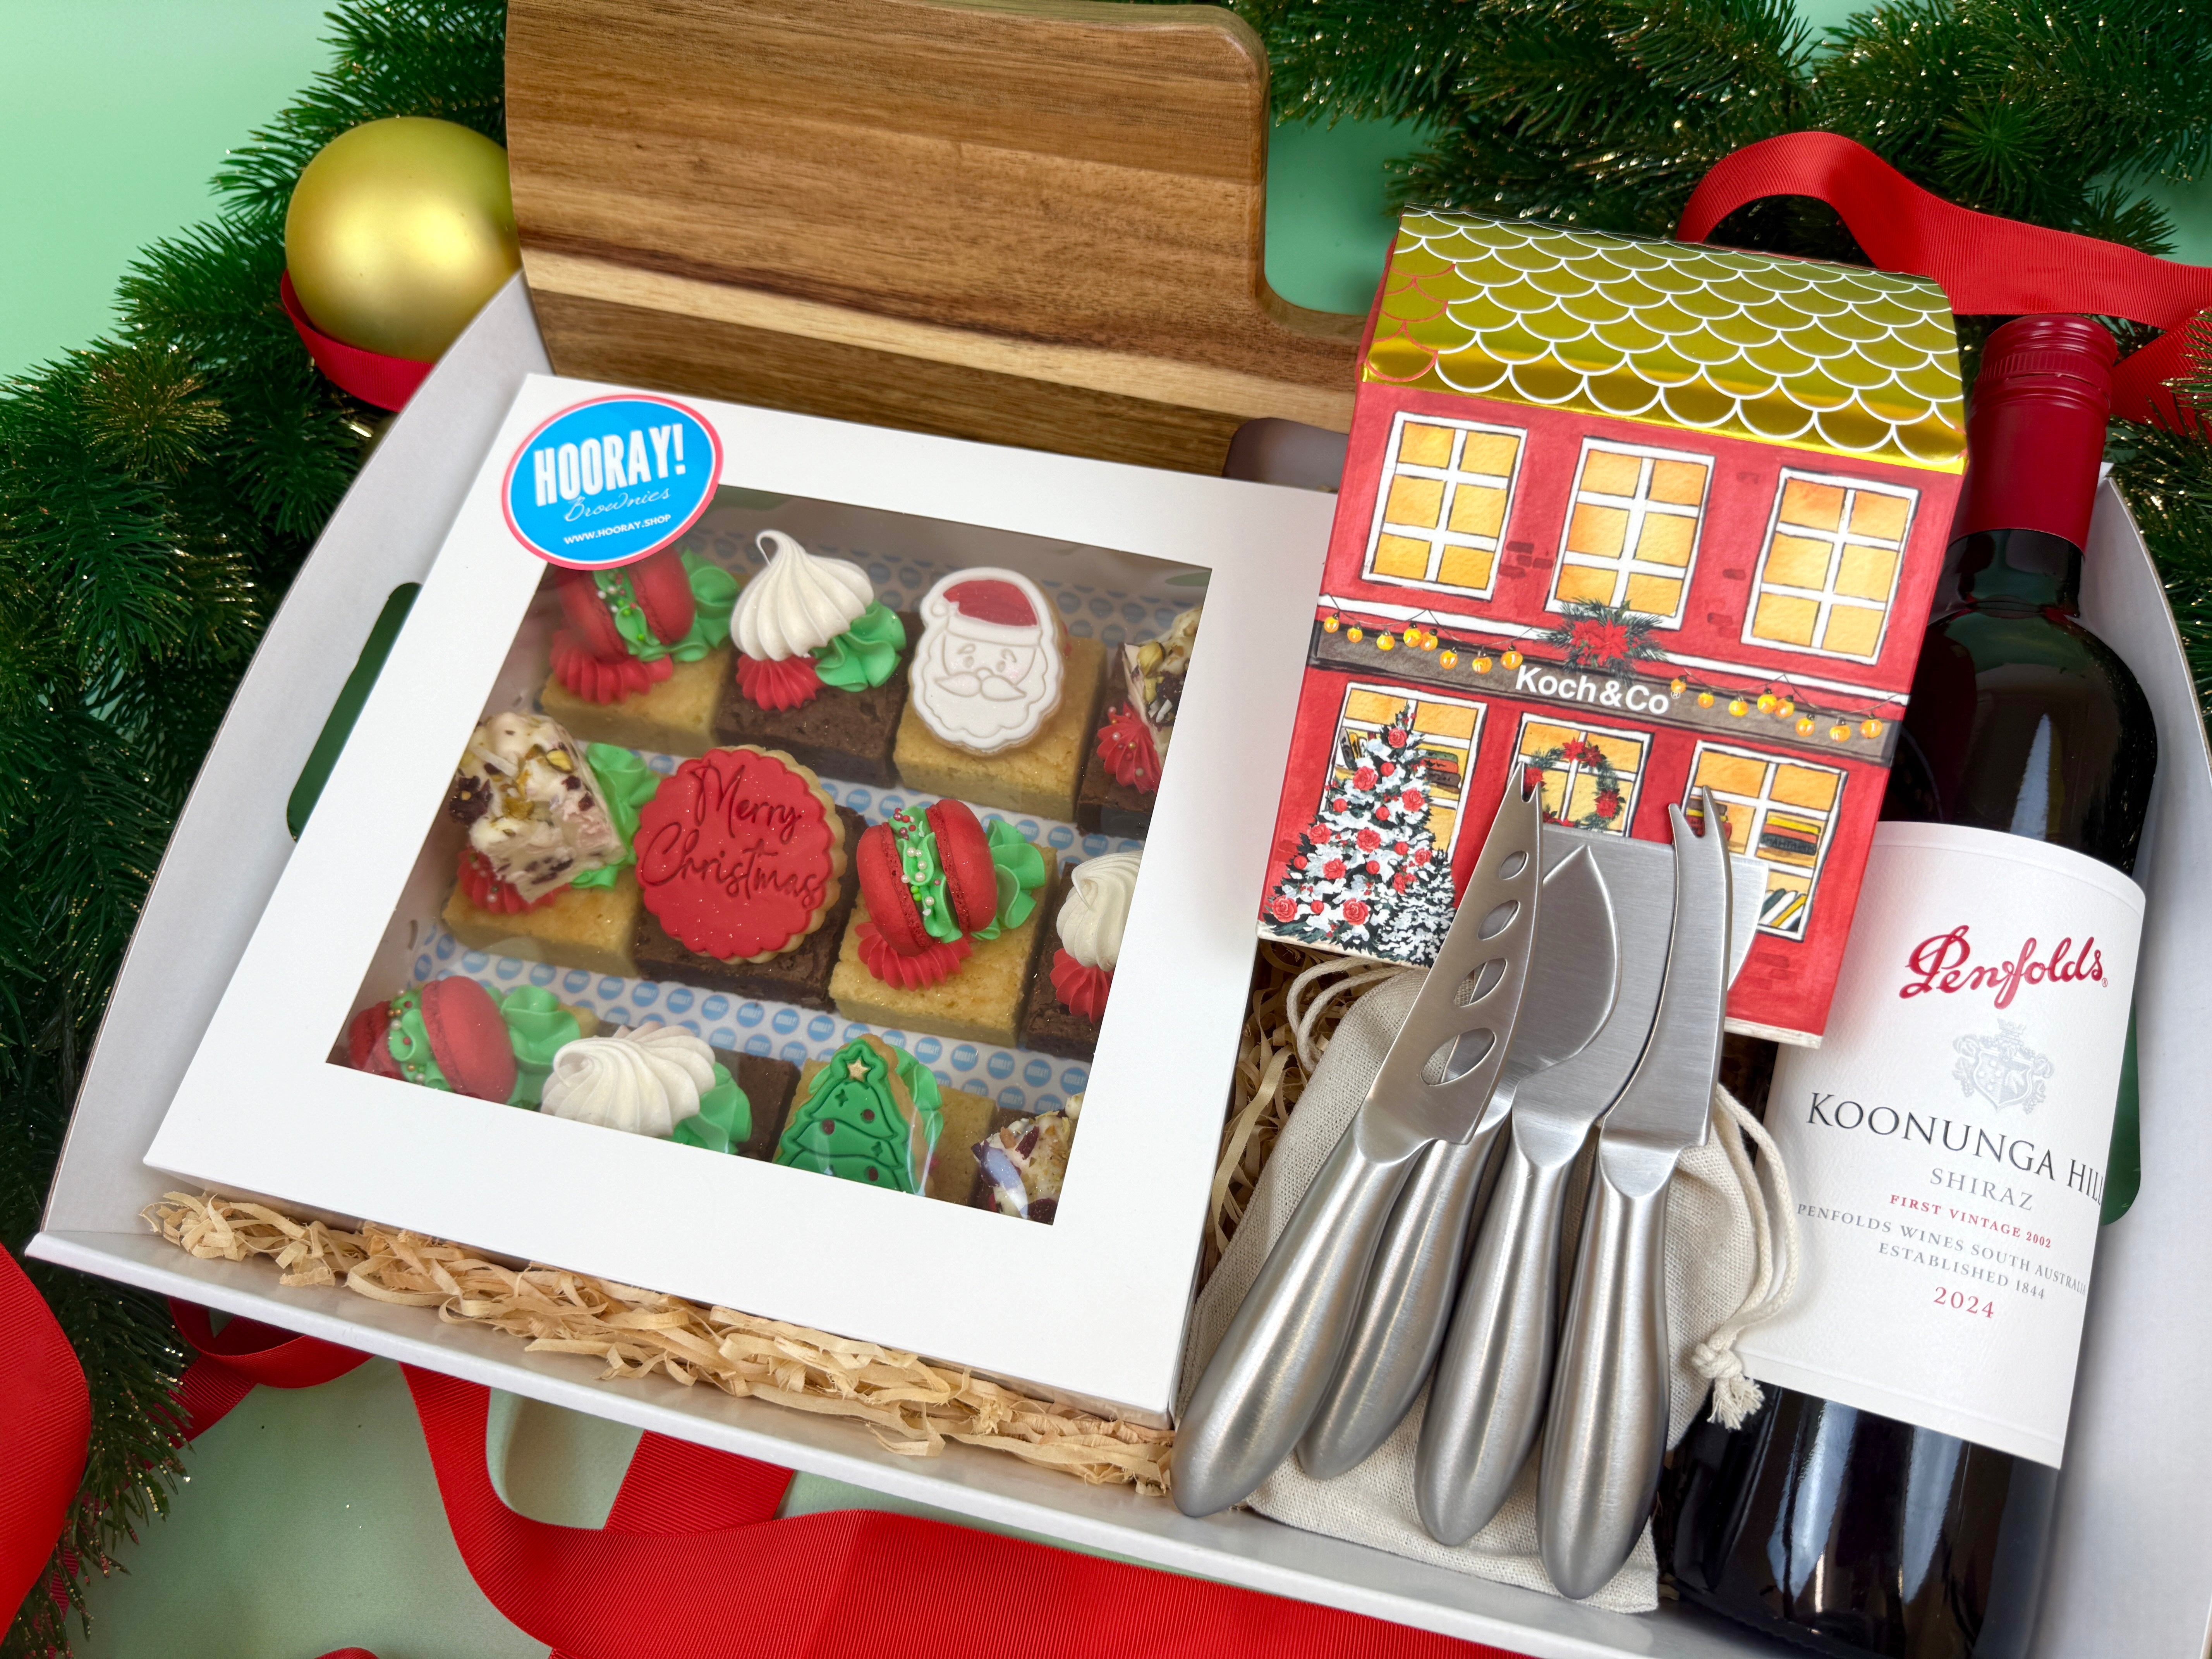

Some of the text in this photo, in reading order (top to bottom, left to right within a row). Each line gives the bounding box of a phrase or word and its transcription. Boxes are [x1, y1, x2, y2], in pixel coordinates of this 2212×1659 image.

[533, 423, 686, 507] HOORAY!
[563, 488, 670, 522] Brownies
[563, 514, 671, 544] WWW.HOORAY.SHOP
[689, 759, 802, 845] Merry
[641, 822, 821, 909] Christmas
[1899, 925, 2103, 1009] Penfolds
[1806, 1092, 2055, 1180] KOONUNGA
[1890, 1194, 2051, 1249] FIRST VINTAGE 2002
[1930, 1168, 2033, 1211] SHIRAZ
[1797, 1204, 2086, 1296] PENFOLDS WINES SOUTH AUSTRALIA
[1879, 1243, 2044, 1299] ESTABLISHED 1844
[1933, 1286, 1994, 1318] 2024
